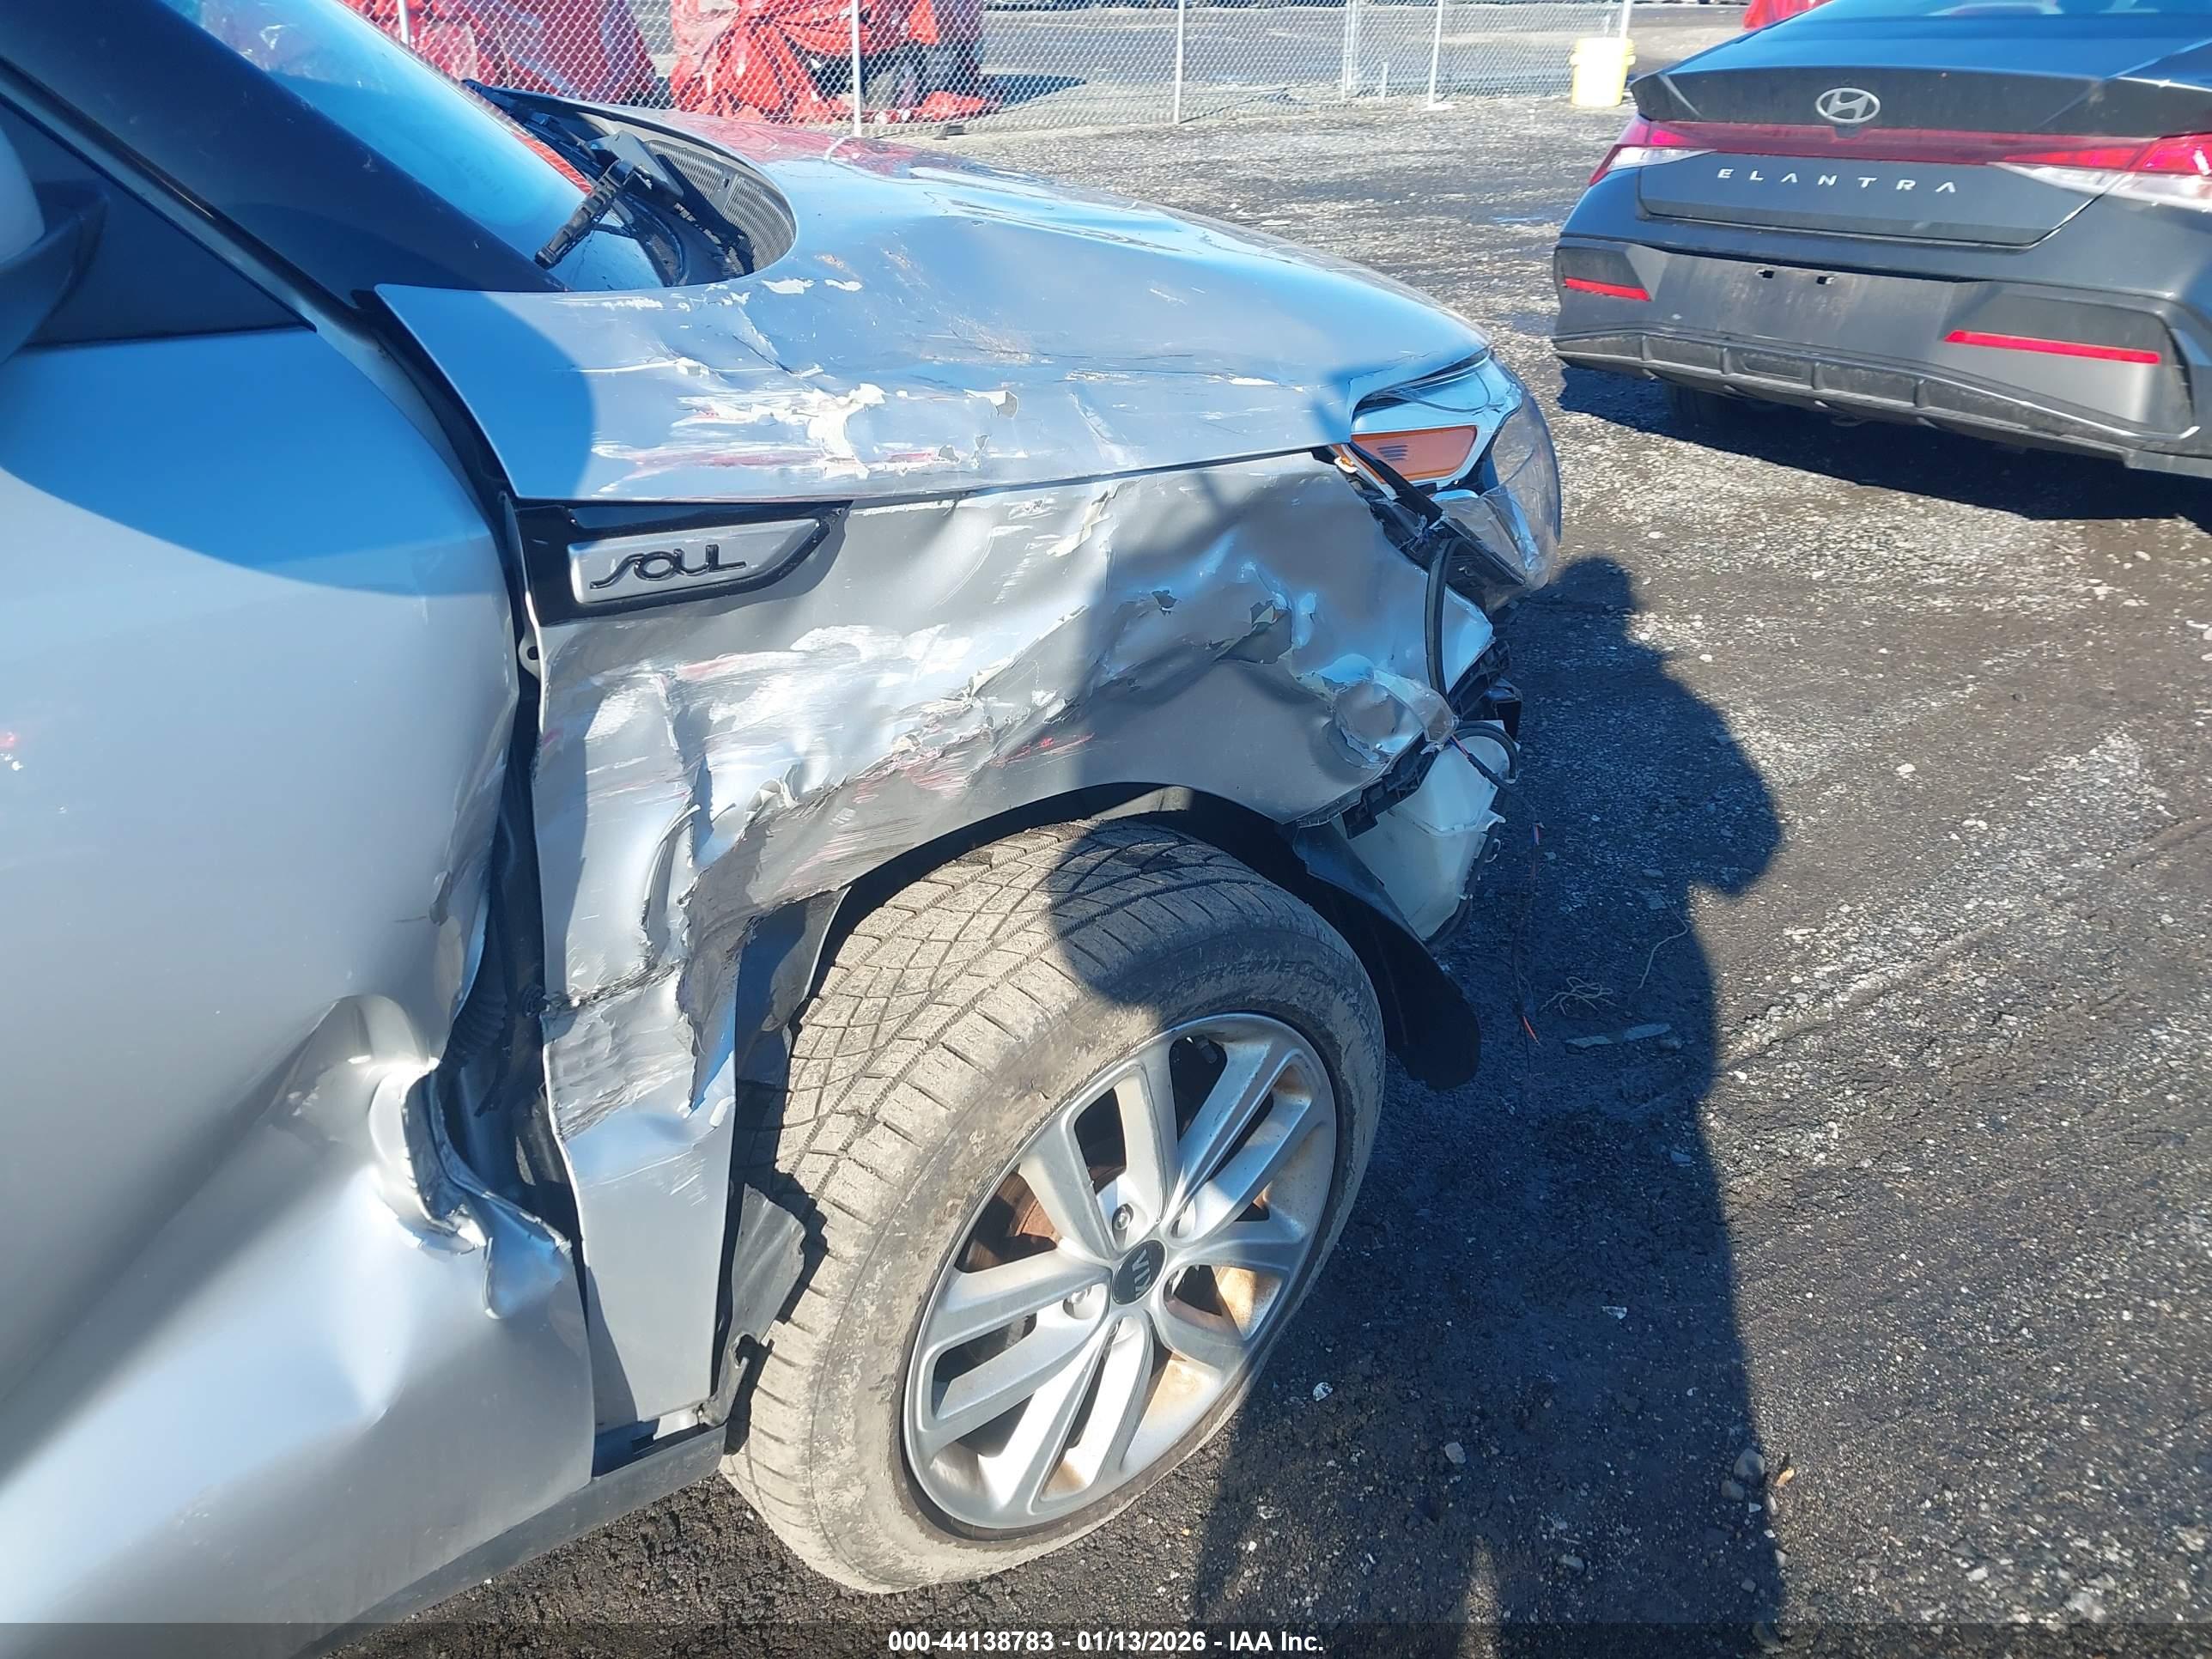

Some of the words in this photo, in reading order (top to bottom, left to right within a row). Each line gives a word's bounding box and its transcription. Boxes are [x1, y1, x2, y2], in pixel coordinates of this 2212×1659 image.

[1717, 167, 1957, 194] ELANTRA
[589, 544, 747, 589] SOUL
[1131, 1249, 1152, 1299] KIA
